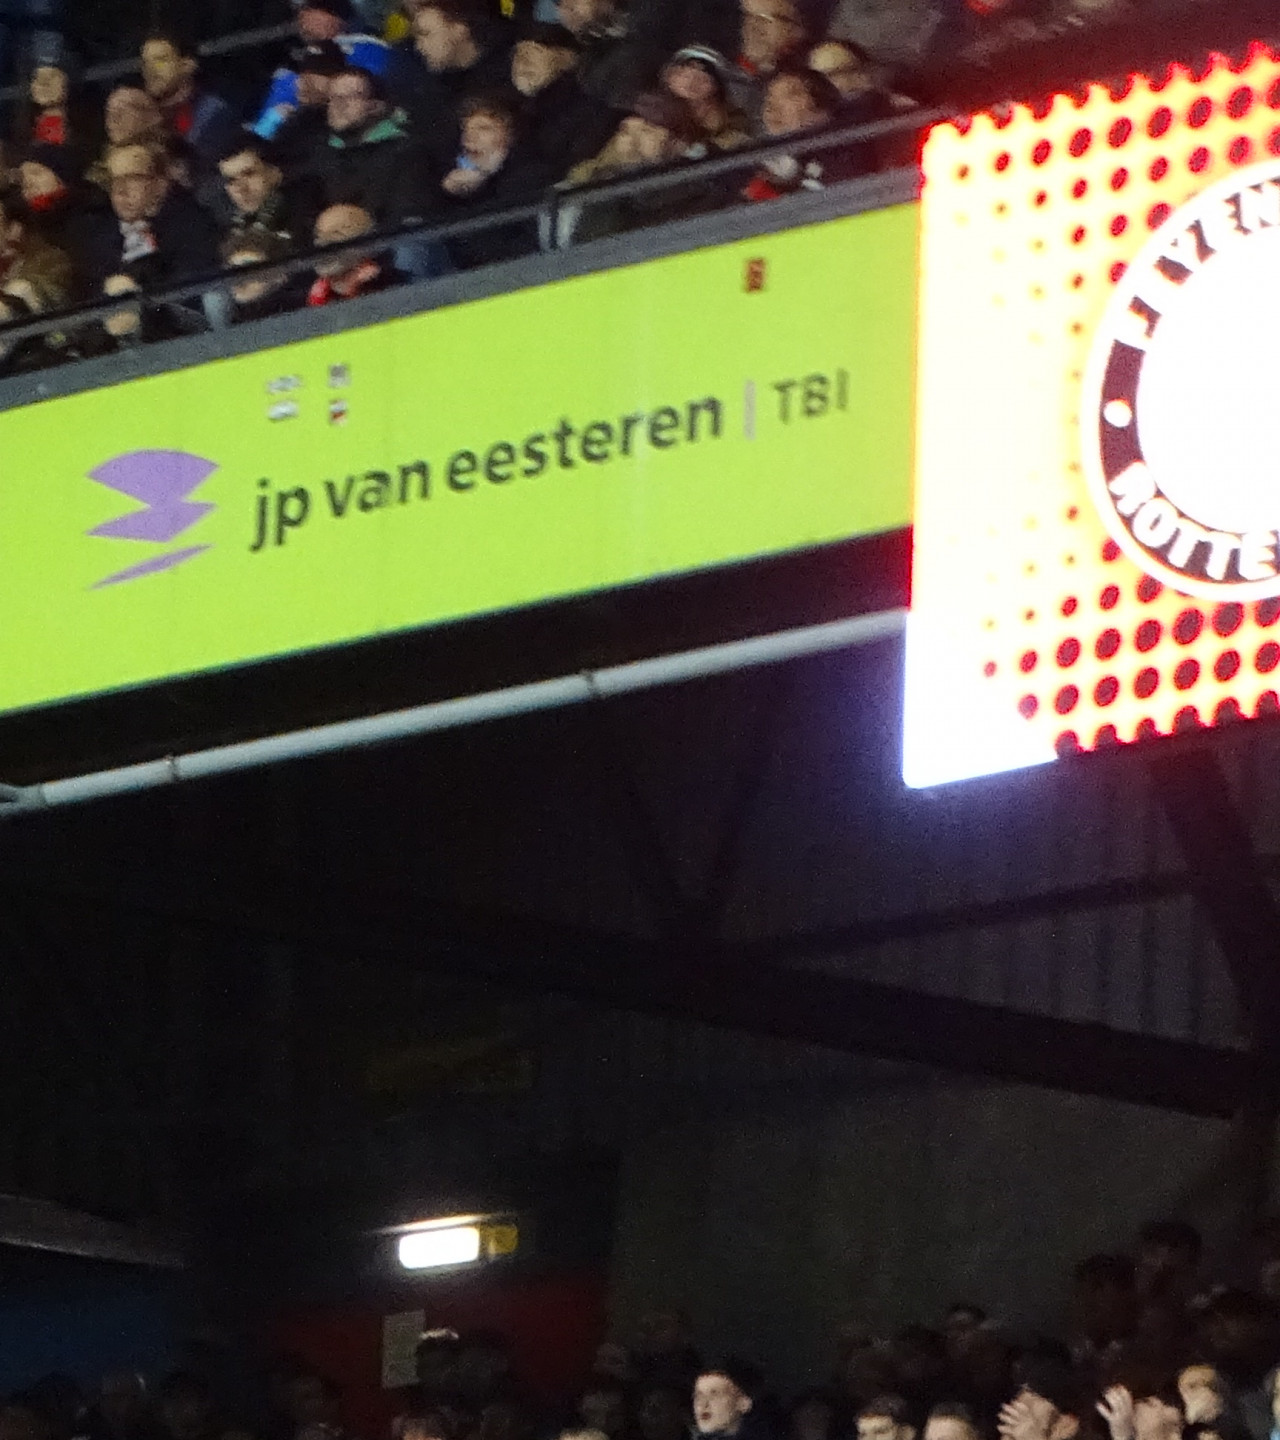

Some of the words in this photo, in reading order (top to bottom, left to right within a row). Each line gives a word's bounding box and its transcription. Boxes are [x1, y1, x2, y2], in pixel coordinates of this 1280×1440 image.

[249, 478, 311, 552] jp
[324, 460, 431, 519] van
[445, 397, 724, 493] eesteren
[771, 367, 850, 425] TBI
